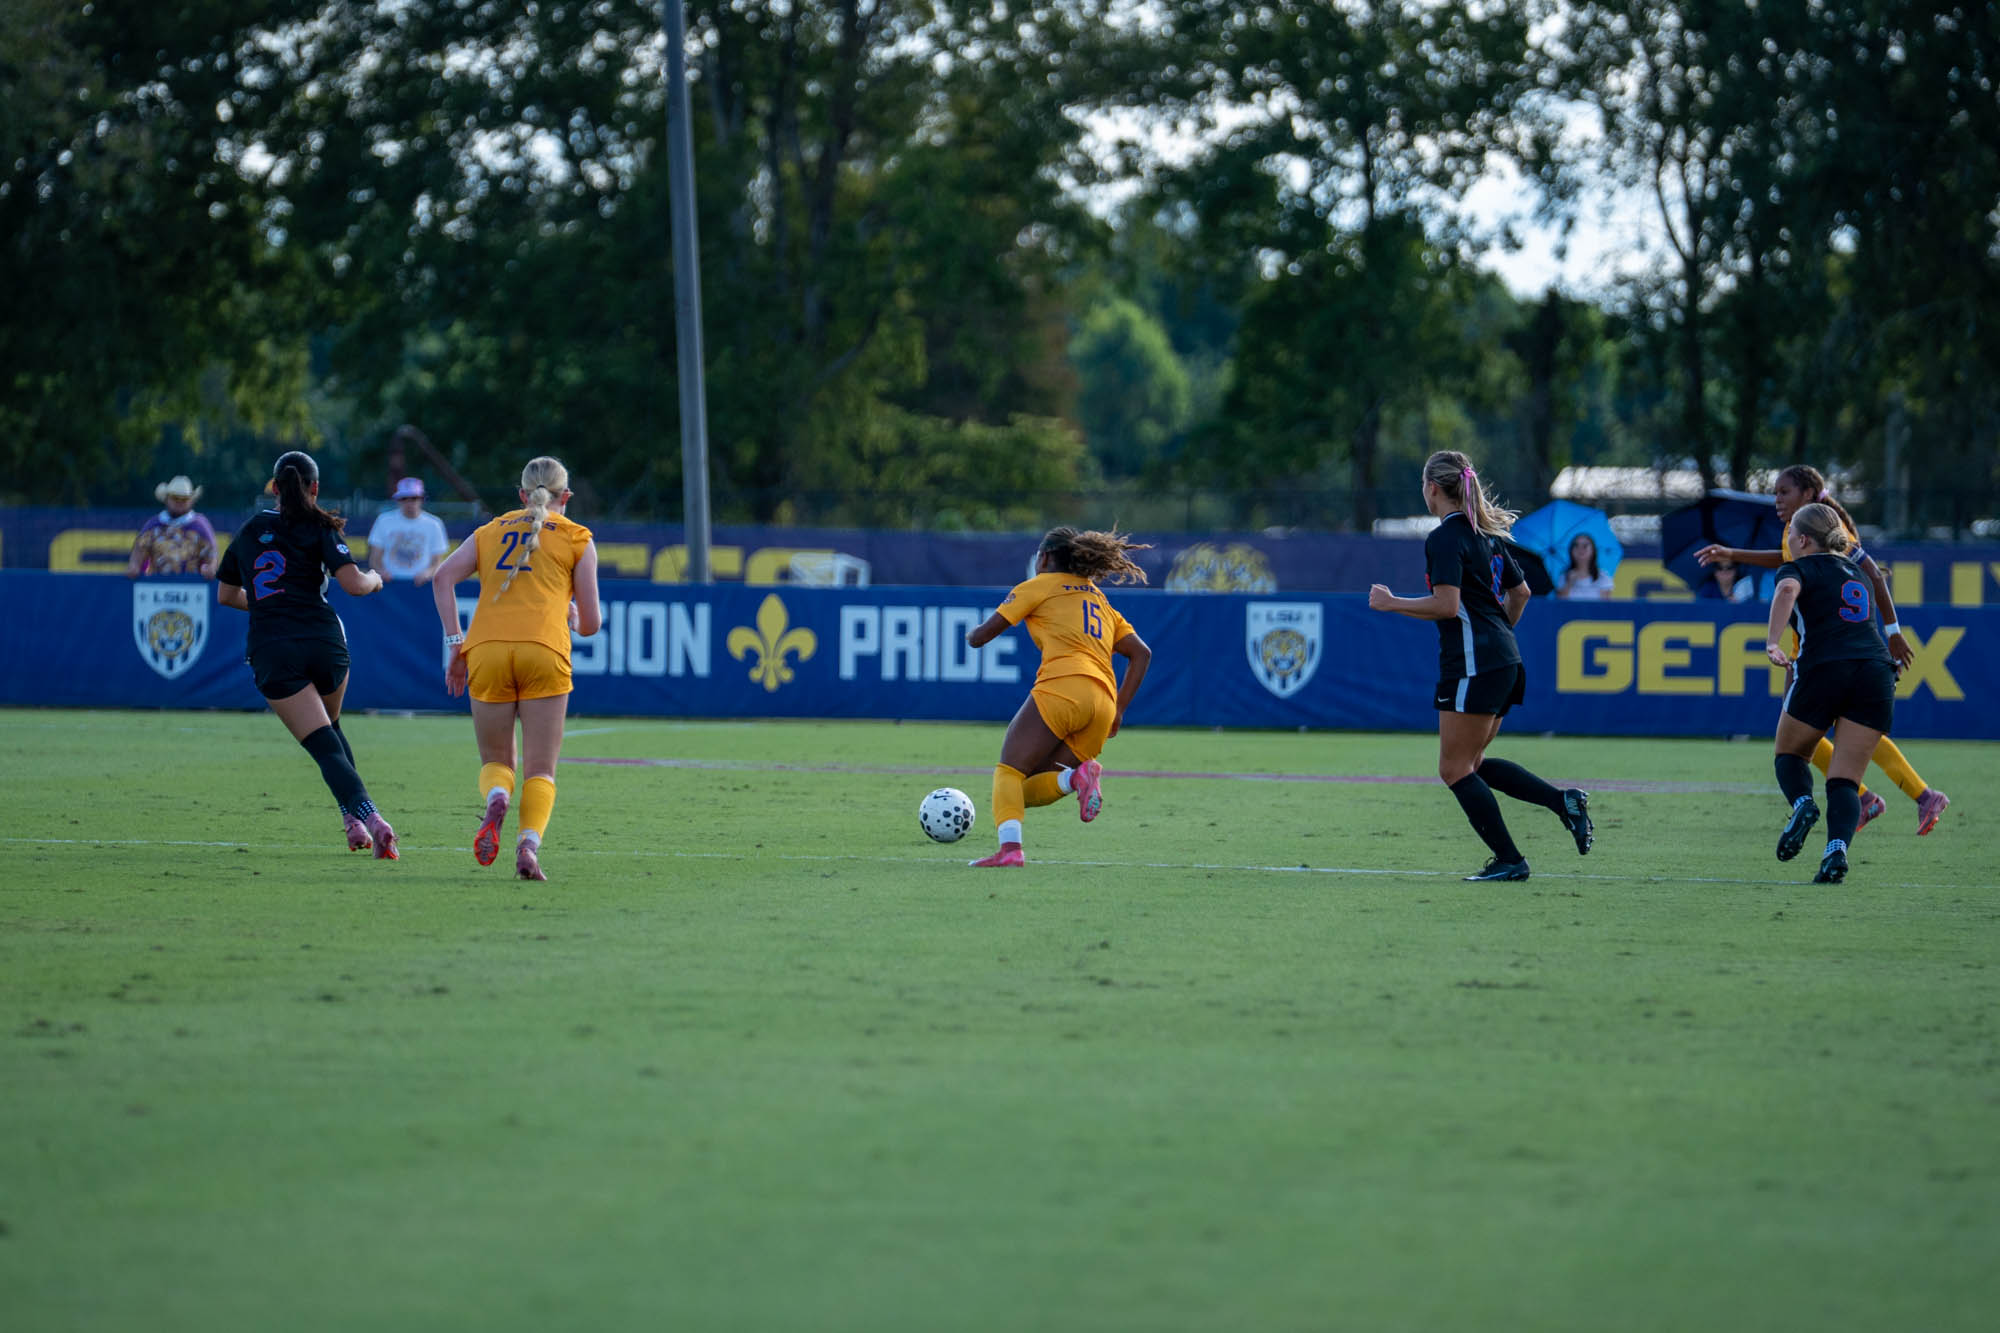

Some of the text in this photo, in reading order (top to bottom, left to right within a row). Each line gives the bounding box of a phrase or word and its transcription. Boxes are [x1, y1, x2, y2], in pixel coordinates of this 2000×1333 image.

[153, 591, 188, 603] LSU
[252, 550, 287, 600] 2
[1082, 600, 1102, 639] 15
[1266, 610, 1302, 622] LSU
[1838, 579, 1870, 623] 9
[443, 597, 711, 678] SION
[839, 605, 1021, 684] PRIDE
[1556, 619, 1966, 701] GEAX
